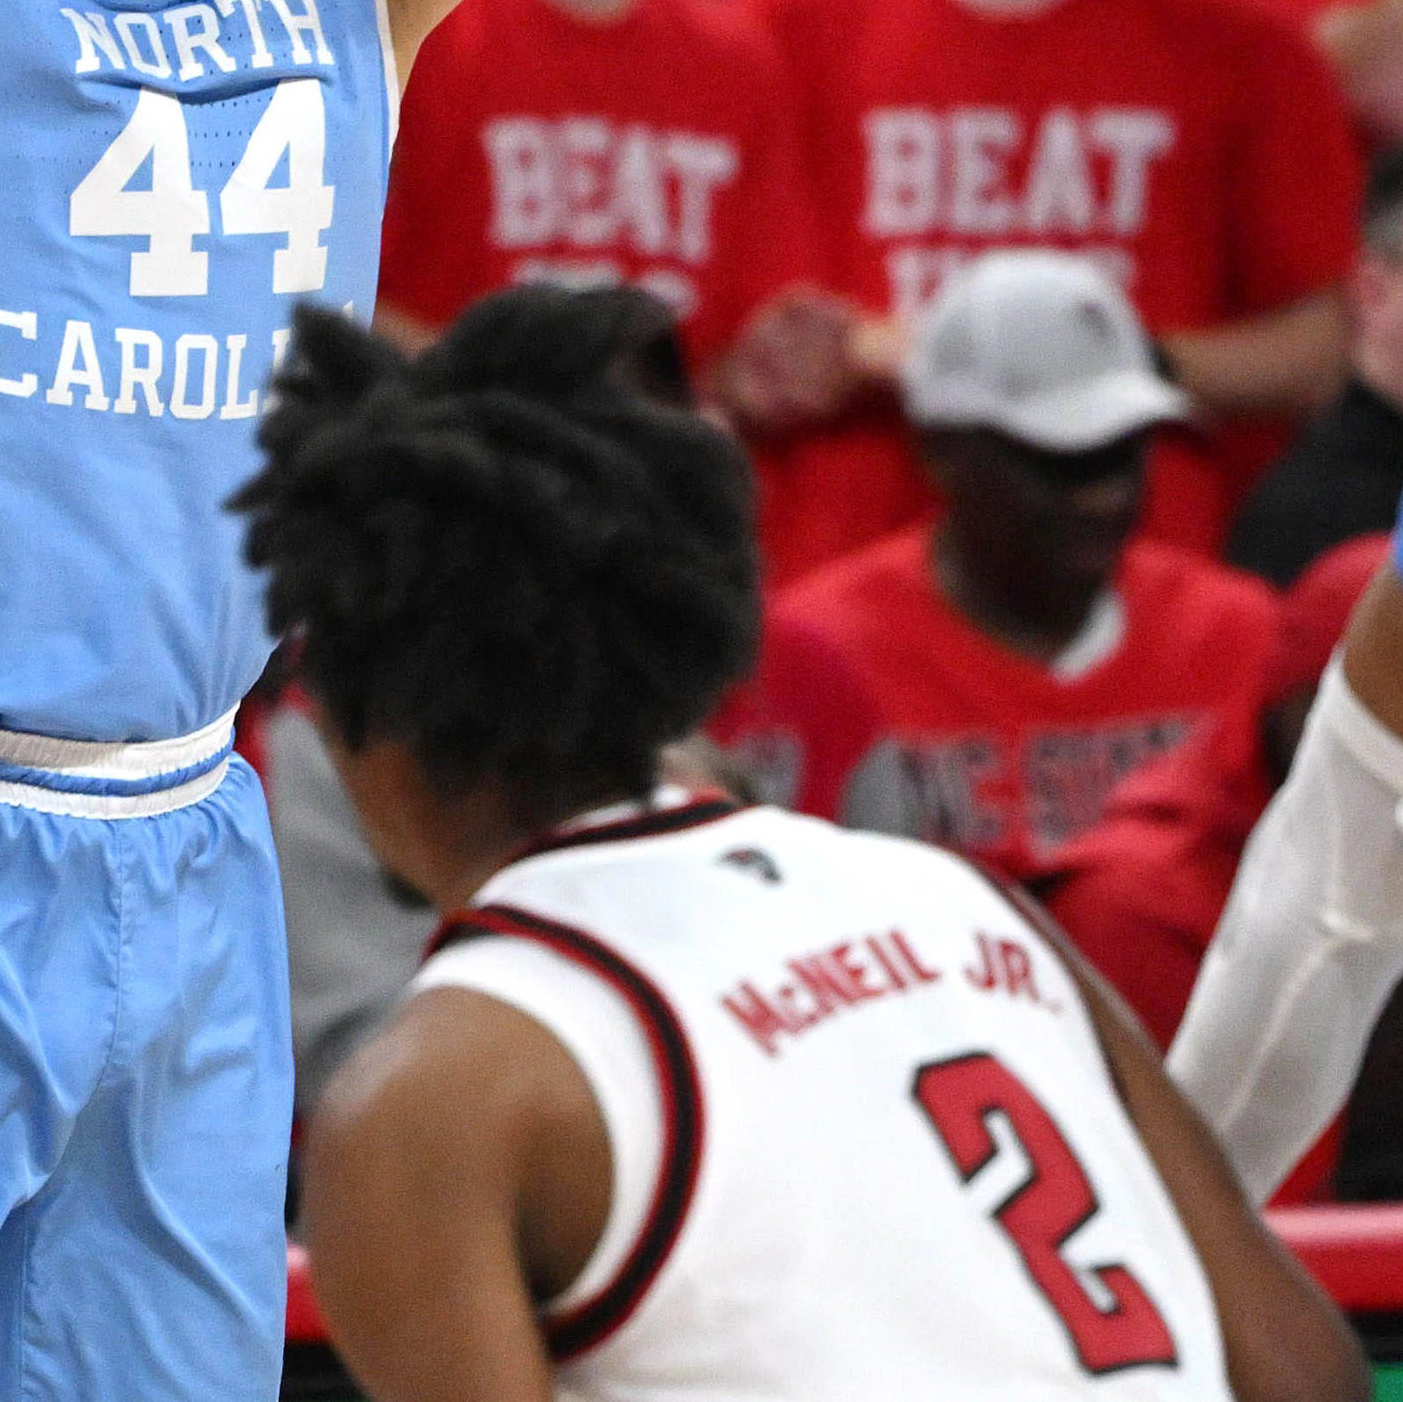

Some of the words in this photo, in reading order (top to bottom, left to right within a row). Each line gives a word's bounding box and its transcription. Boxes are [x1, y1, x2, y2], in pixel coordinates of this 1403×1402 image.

[70, 78, 336, 296] 44
[483, 115, 740, 263] BEAT
[860, 105, 1178, 236] BEAT
[911, 1048, 1180, 1376] 2
